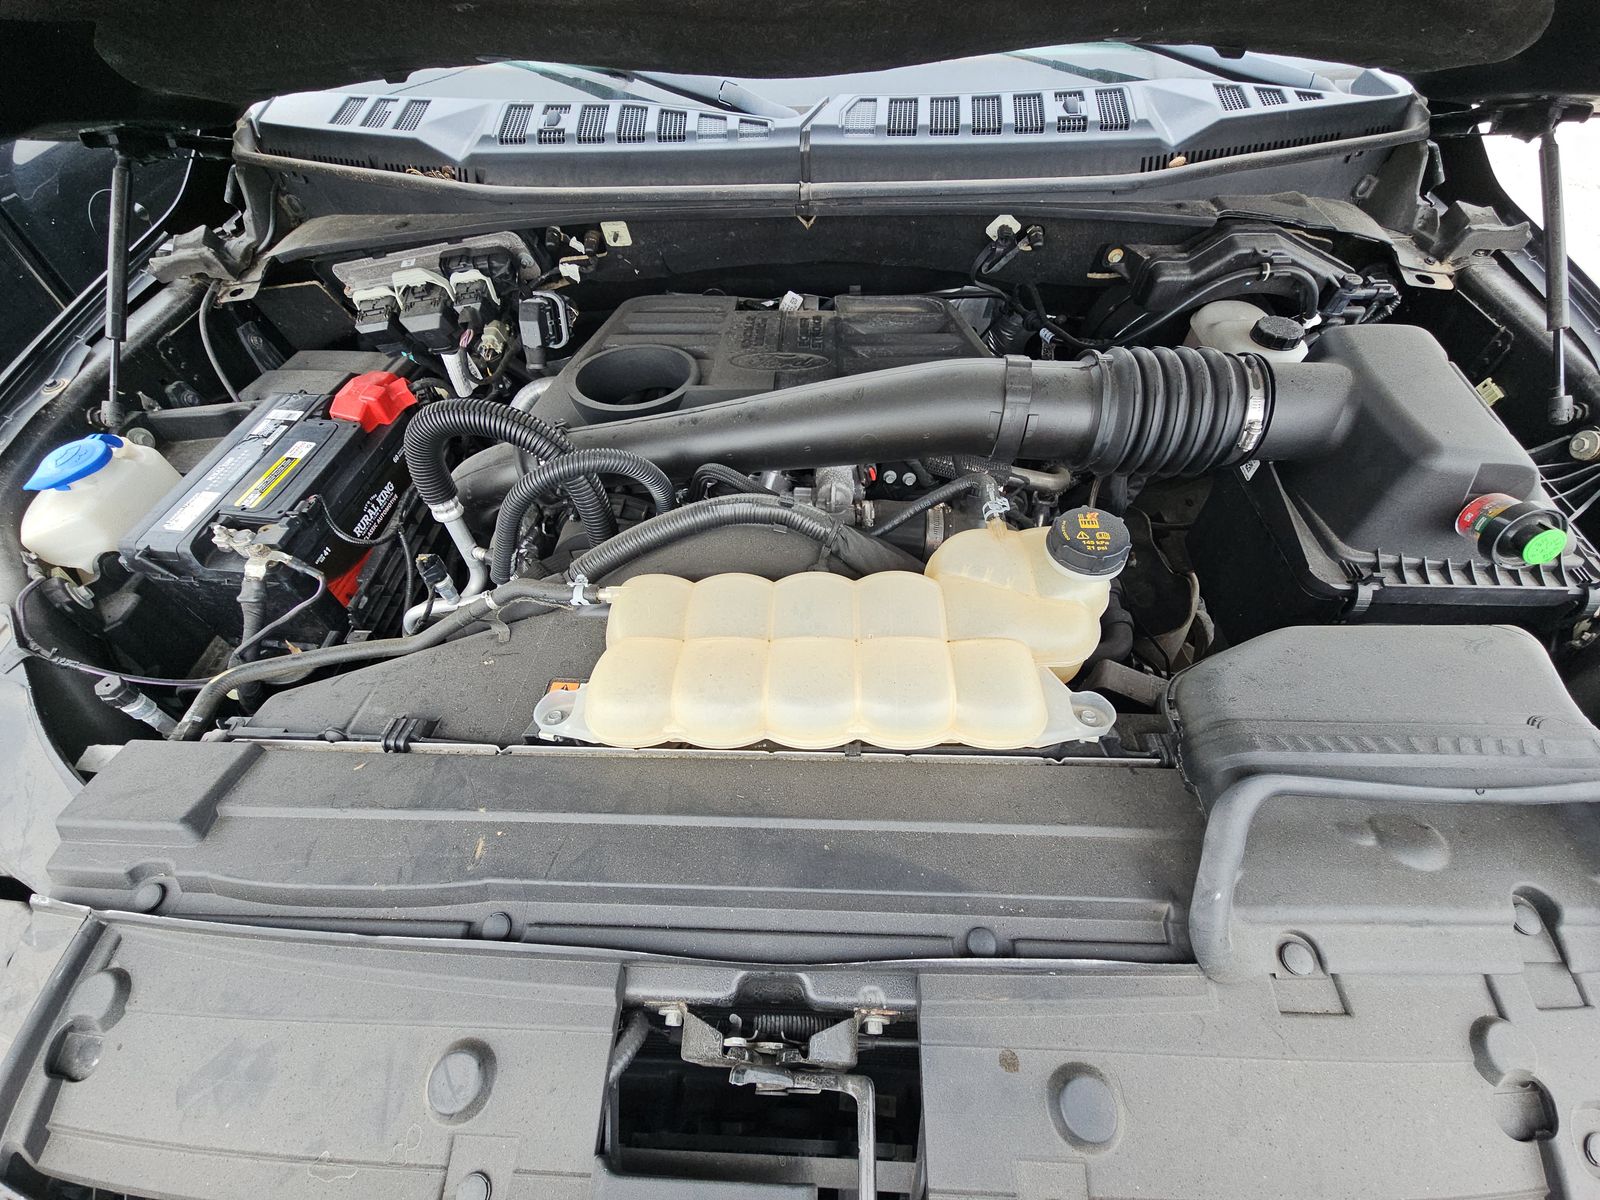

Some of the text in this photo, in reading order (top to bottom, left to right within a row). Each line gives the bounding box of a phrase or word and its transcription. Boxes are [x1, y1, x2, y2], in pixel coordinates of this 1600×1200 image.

[353, 503, 380, 538] RURAL
[376, 481, 395, 507] KING
[376, 493, 399, 525] AUTOMOTIVE
[323, 546, 332, 557] 41
